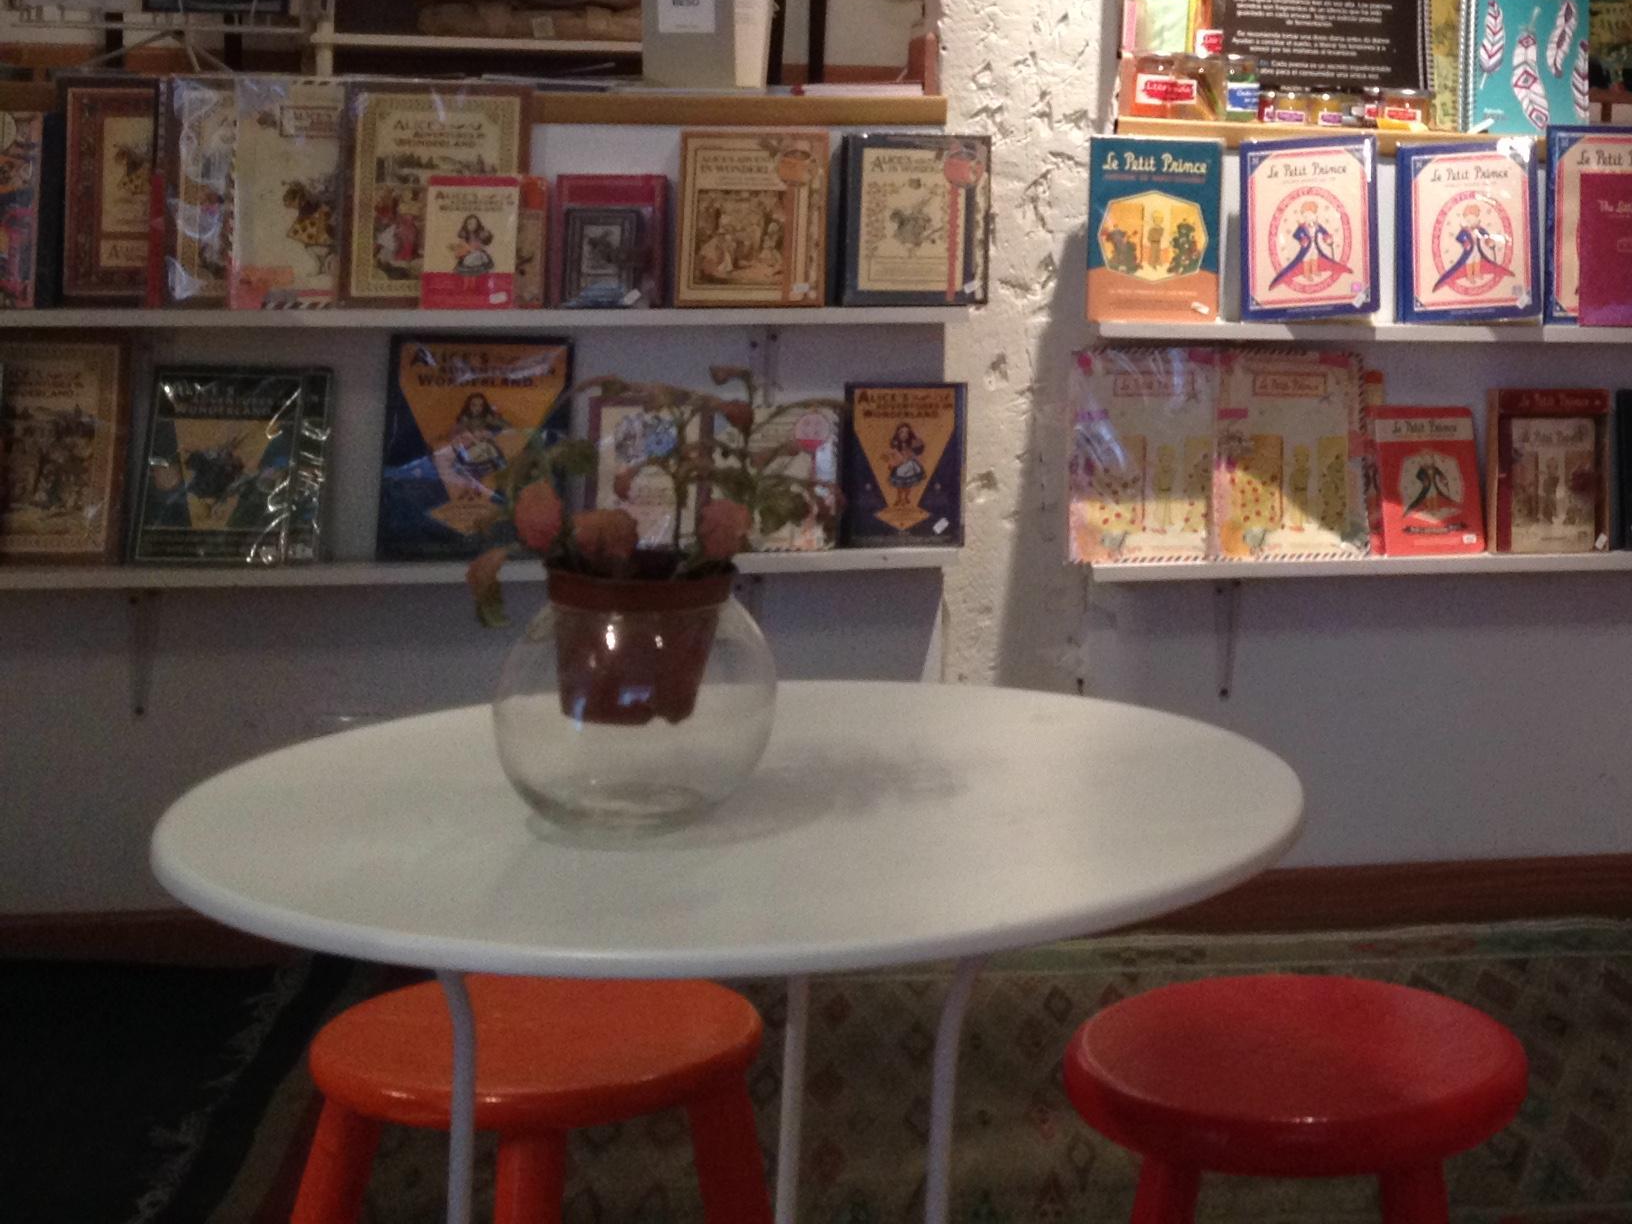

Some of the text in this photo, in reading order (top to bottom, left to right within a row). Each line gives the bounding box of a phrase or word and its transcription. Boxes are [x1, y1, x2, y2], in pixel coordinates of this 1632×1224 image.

[1102, 152, 1206, 174] Le Petit Prince
[1577, 150, 1589, 166] Le
[1596, 149, 1623, 166] Petit
[1267, 162, 1346, 179] Le Petit Prince
[1430, 166, 1509, 182] Le Petit Prince
